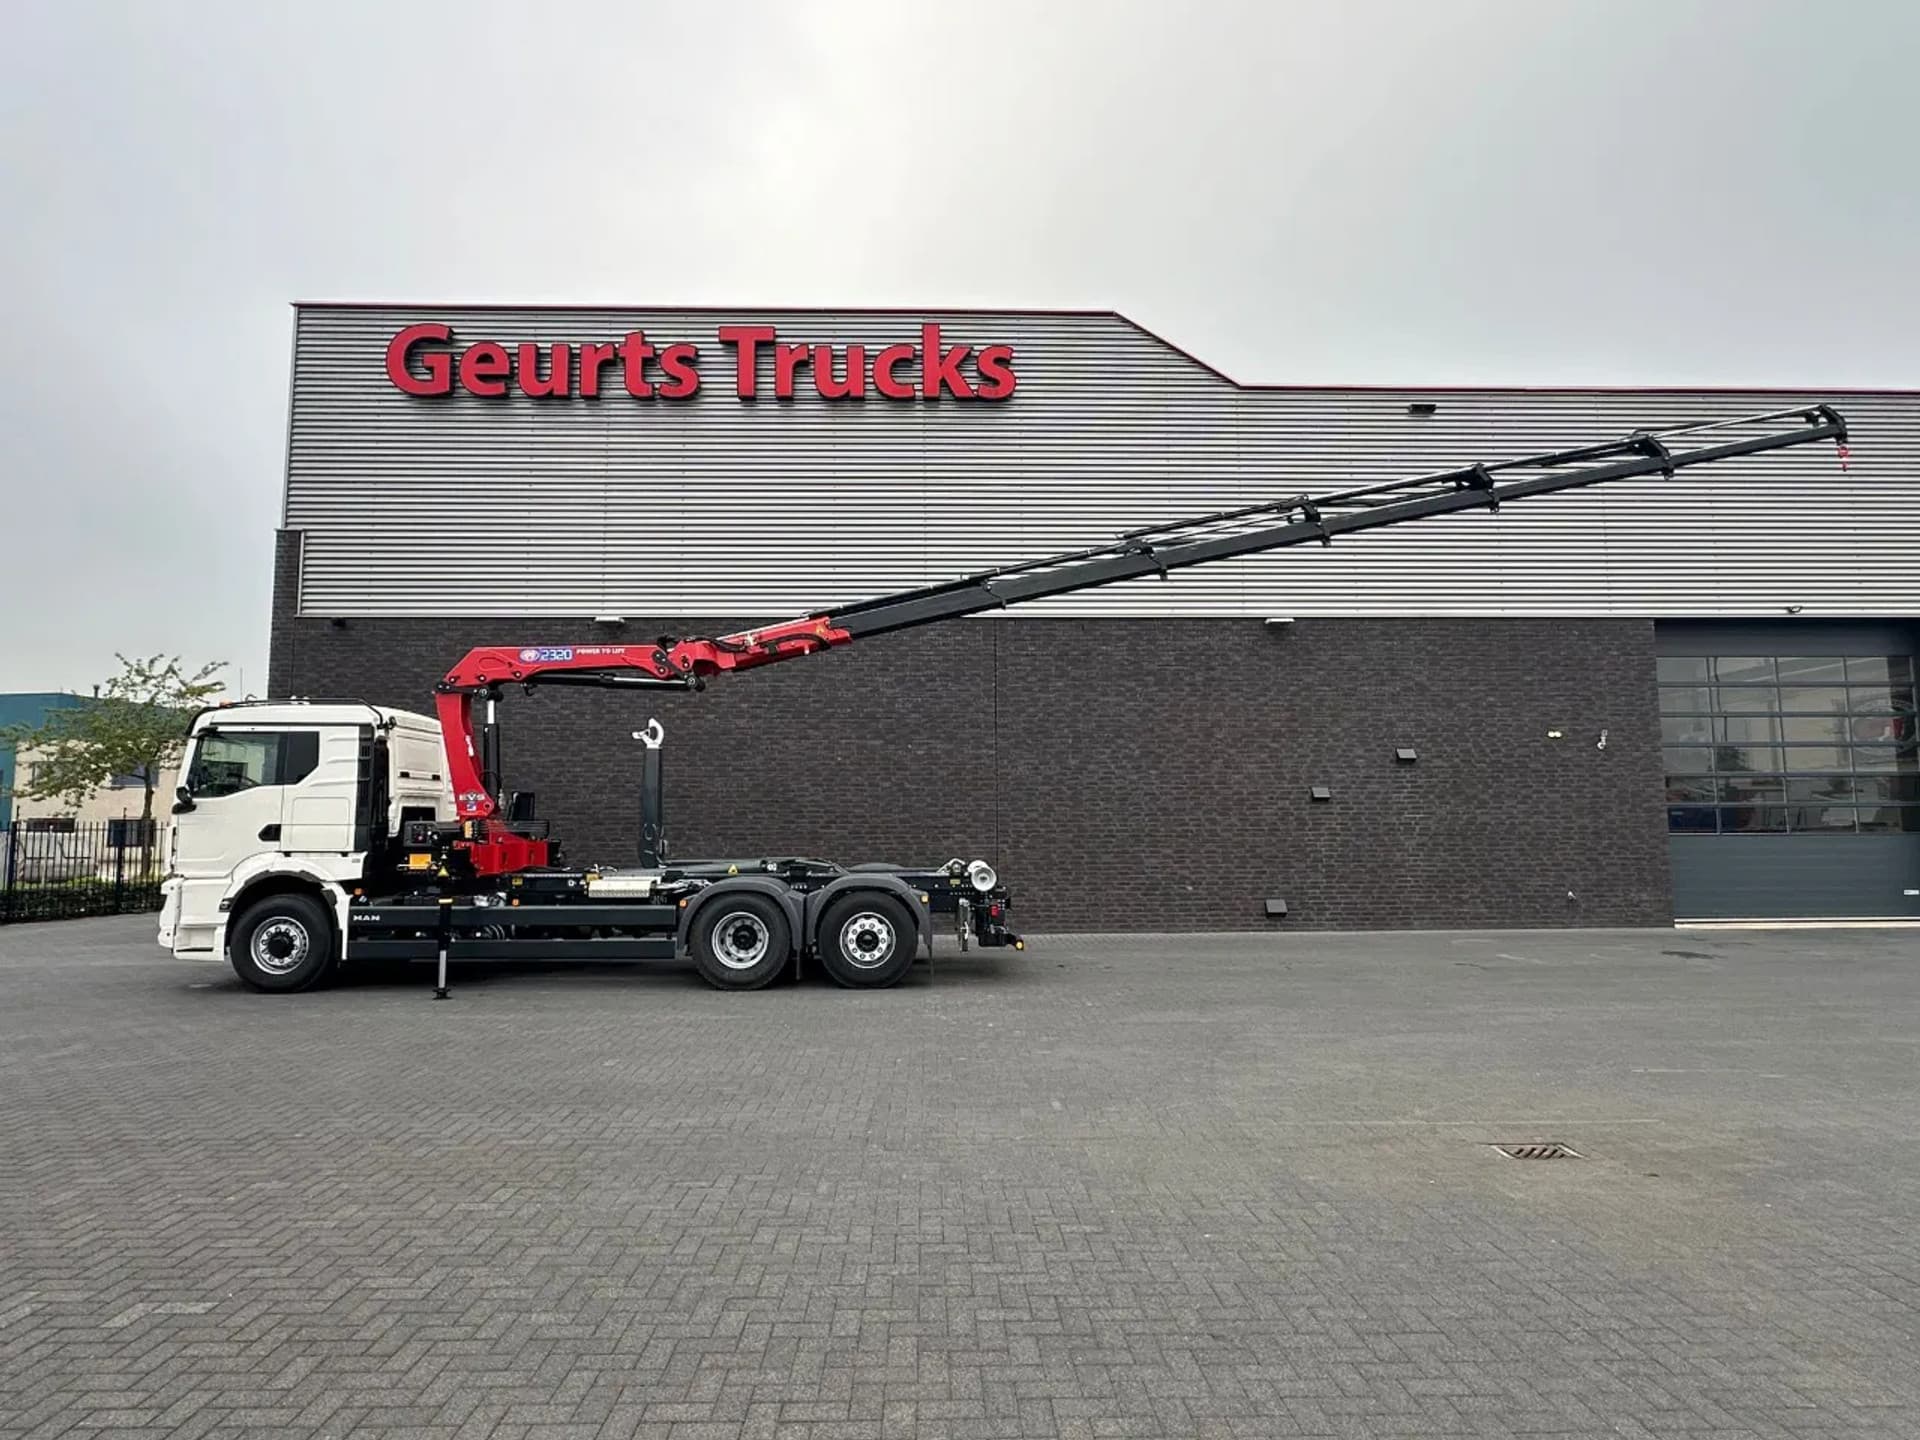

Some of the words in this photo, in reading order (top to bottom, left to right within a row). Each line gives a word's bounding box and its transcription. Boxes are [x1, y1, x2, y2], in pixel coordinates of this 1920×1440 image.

[386, 322, 701, 399] Geurts
[718, 322, 1017, 400] Trucks
[541, 649, 572, 661] 2320
